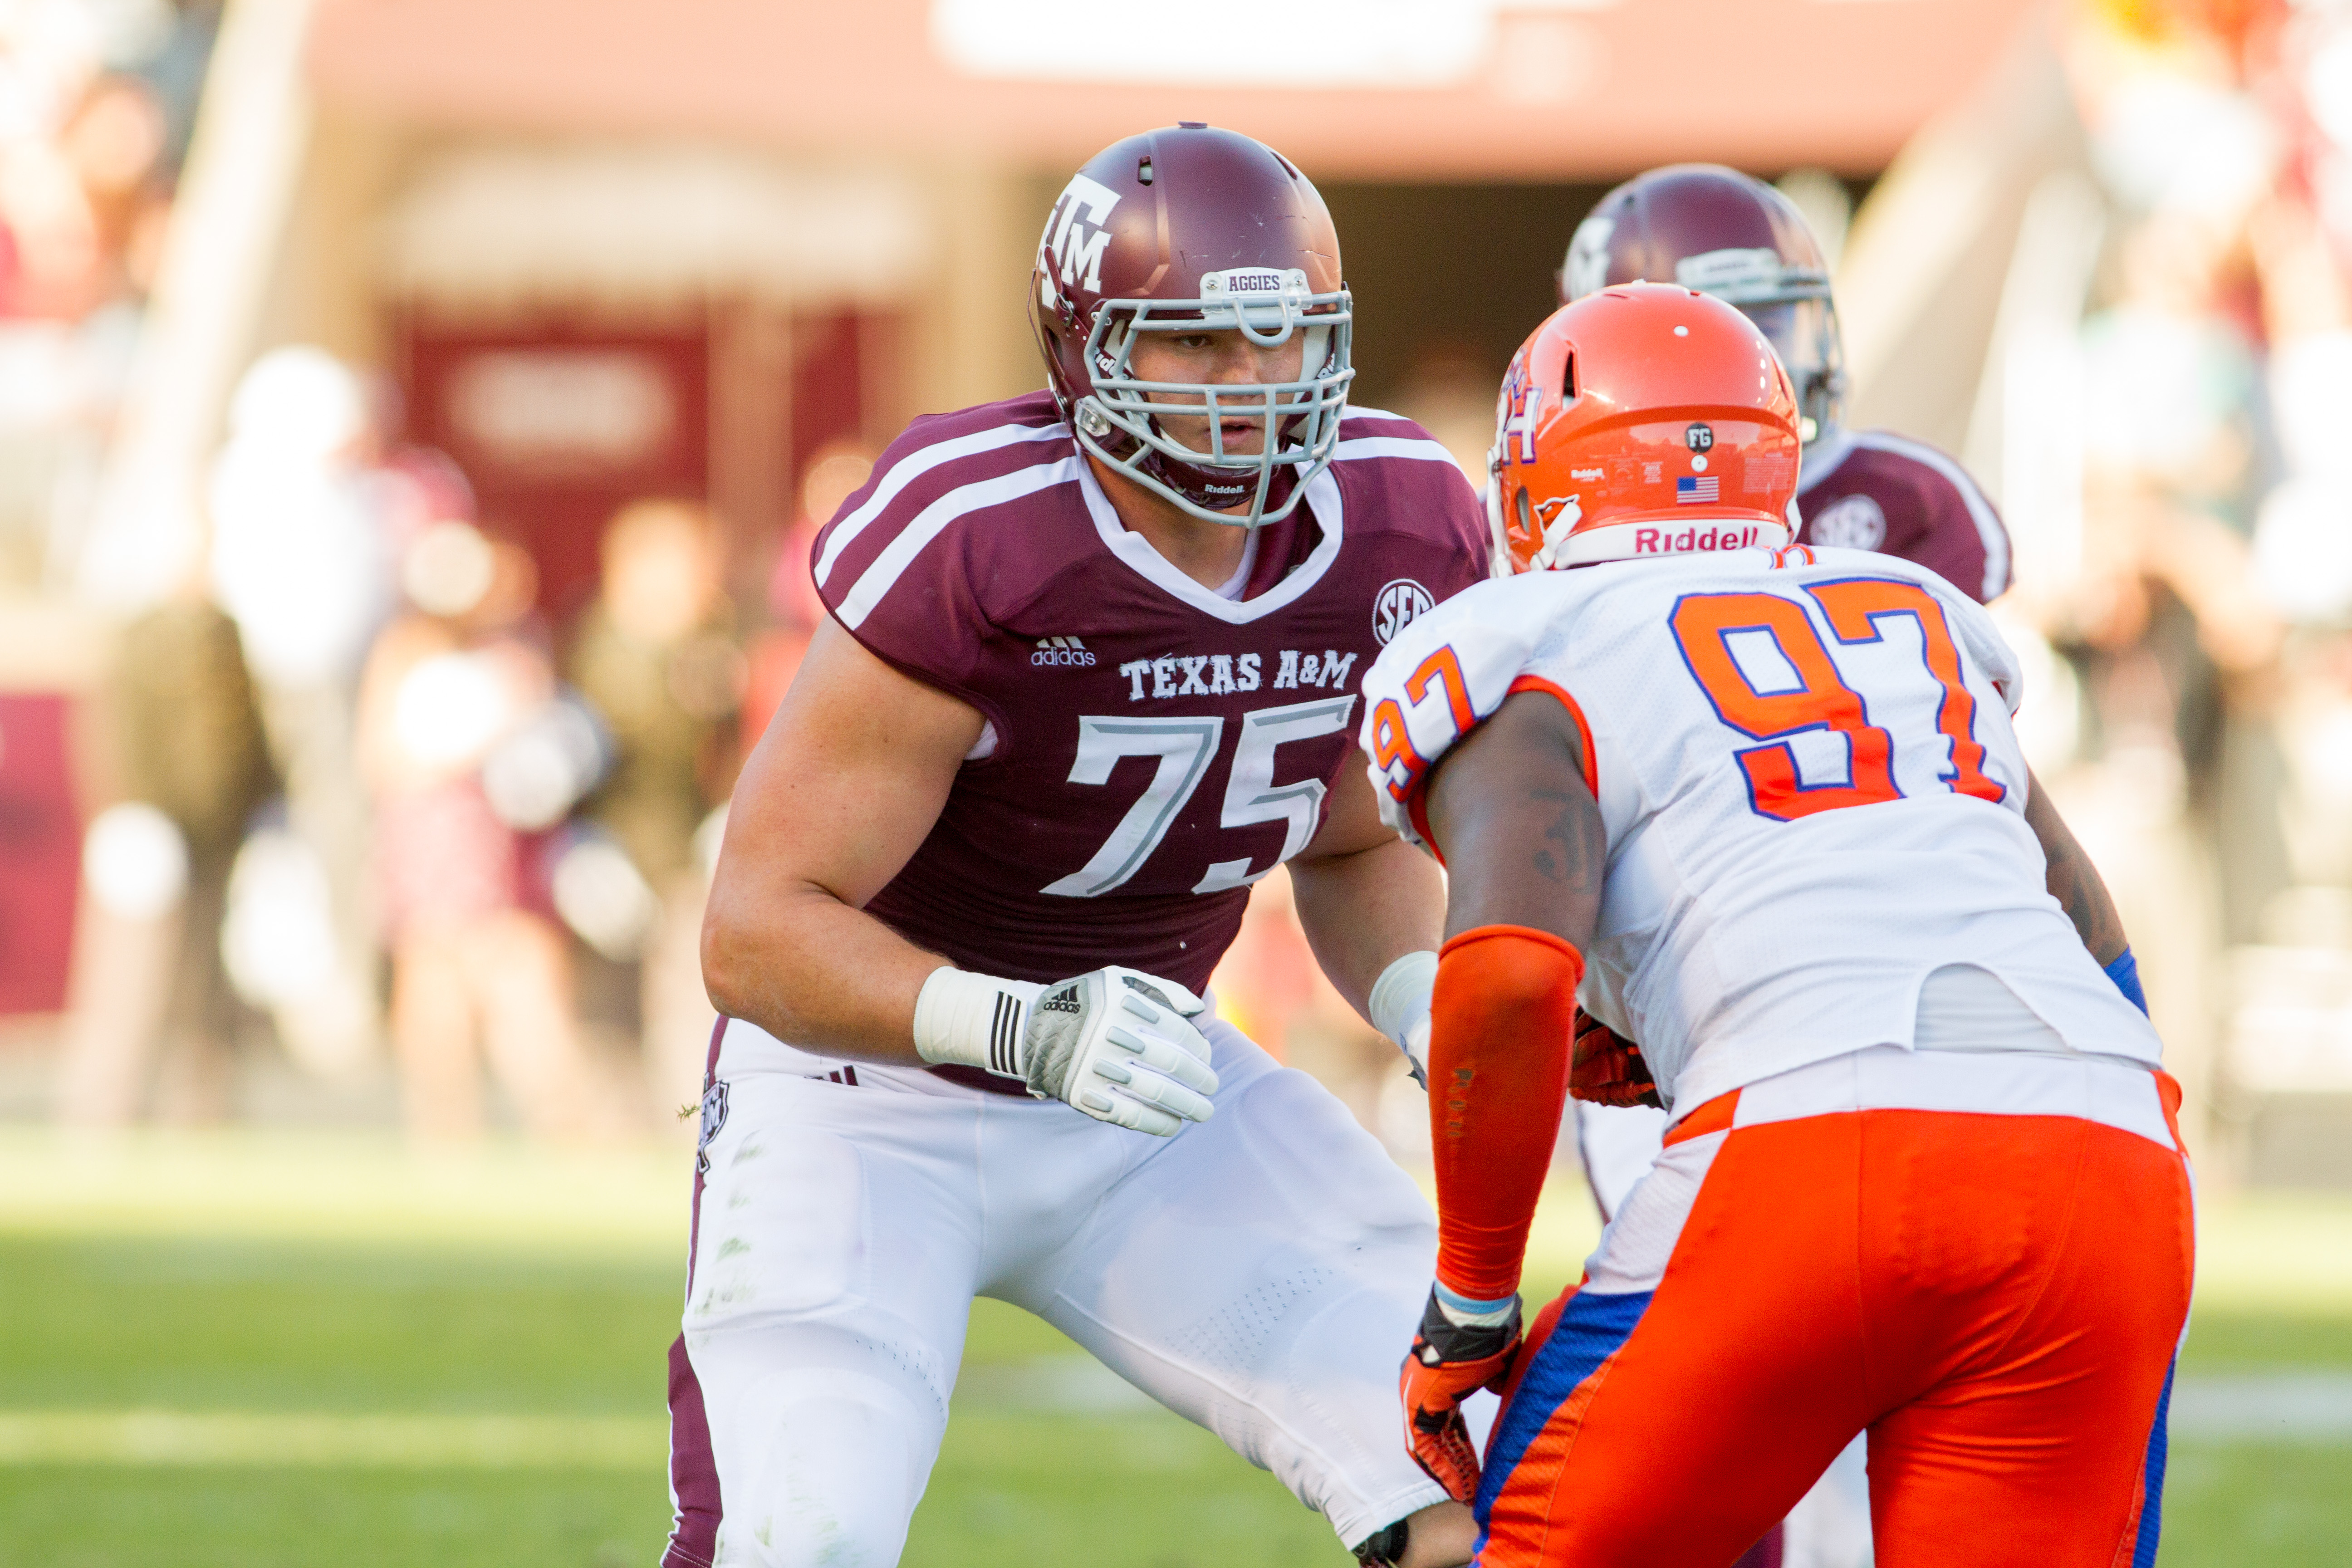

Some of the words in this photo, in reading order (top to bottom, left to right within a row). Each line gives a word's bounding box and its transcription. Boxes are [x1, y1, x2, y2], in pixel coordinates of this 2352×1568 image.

[1229, 275, 1280, 291] AGGIES
[1688, 428, 1711, 448] FG
[1205, 484, 1245, 494] Riddell
[1636, 527, 1758, 553] Riddell
[1031, 646, 1096, 666] adidas
[1119, 653, 1261, 701] TEXAS
[1273, 650, 1358, 690] A&M
[1666, 577, 2007, 823] 97
[1372, 642, 1475, 804] 97
[1039, 693, 1357, 898] 75
[1043, 999, 1081, 1014] adidas
